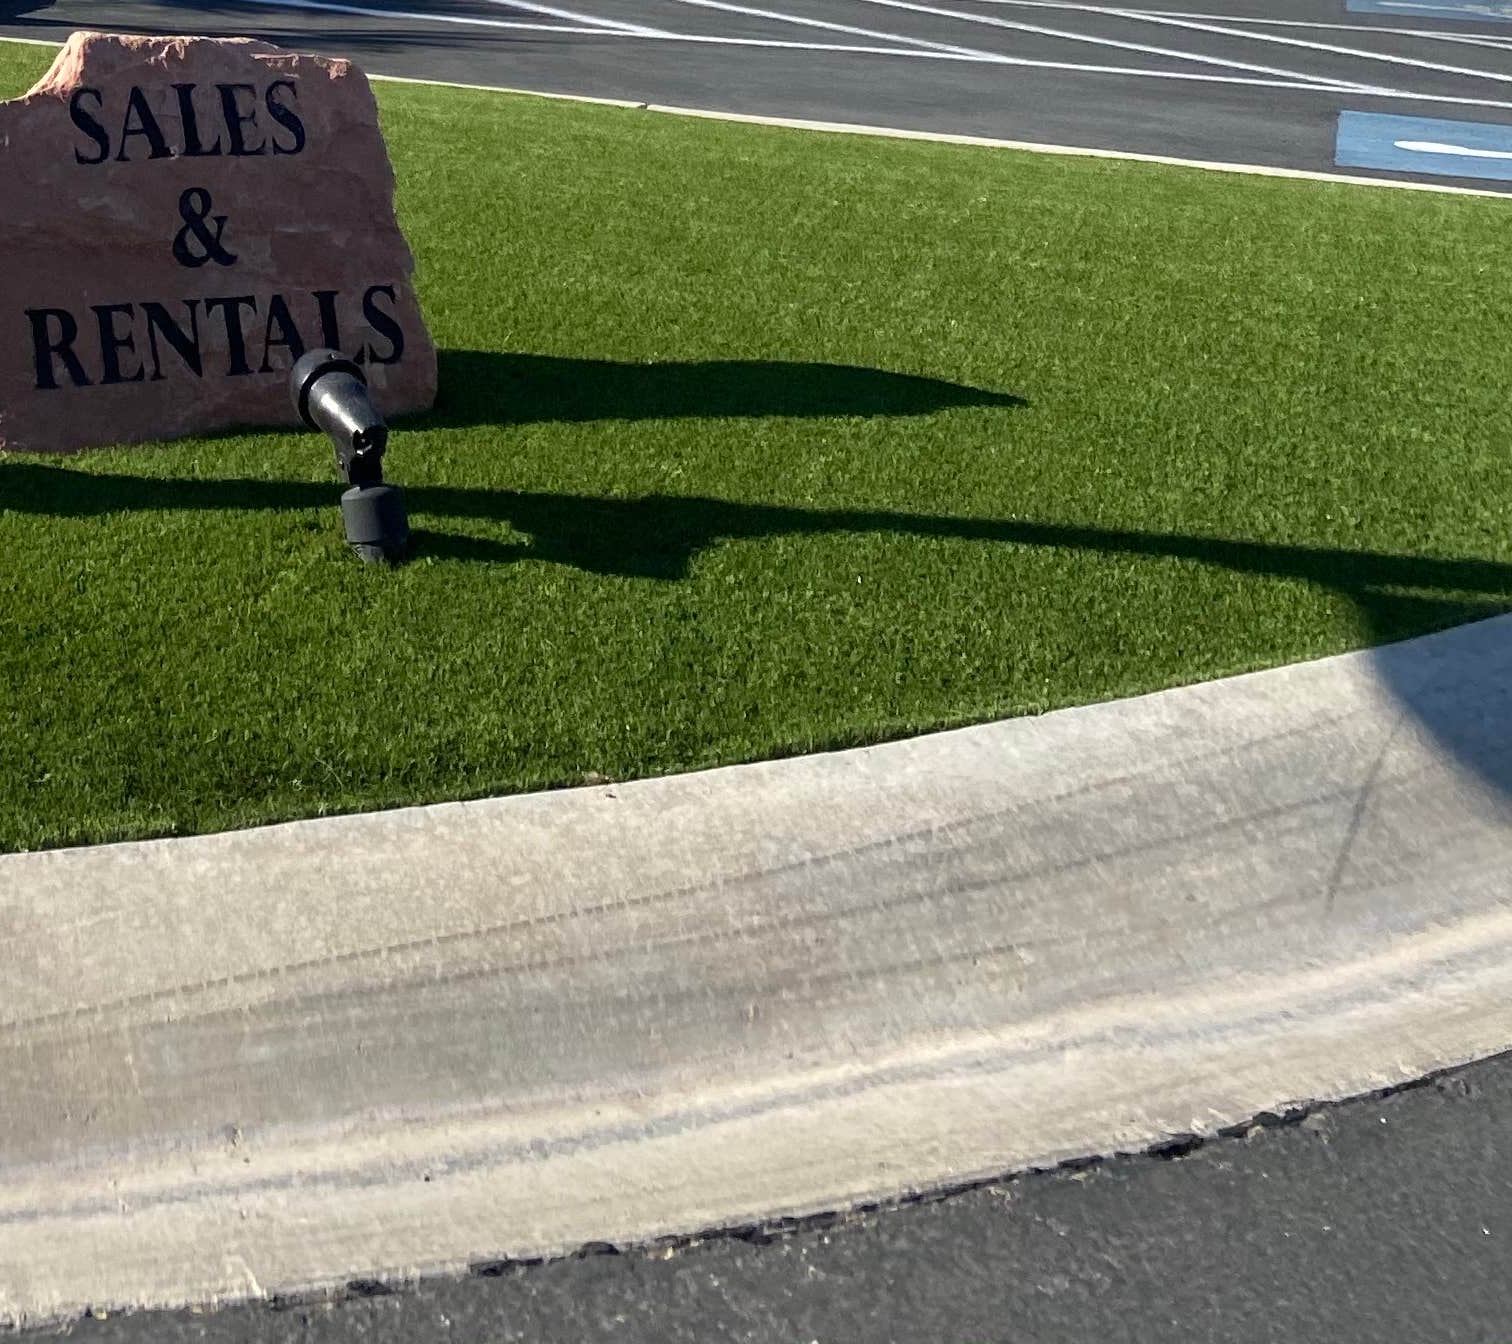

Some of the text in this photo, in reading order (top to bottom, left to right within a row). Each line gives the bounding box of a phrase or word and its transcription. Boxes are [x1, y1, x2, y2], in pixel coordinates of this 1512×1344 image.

[68, 80, 307, 166] SALES
[171, 186, 239, 269] &
[23, 283, 406, 392] RENTALS
